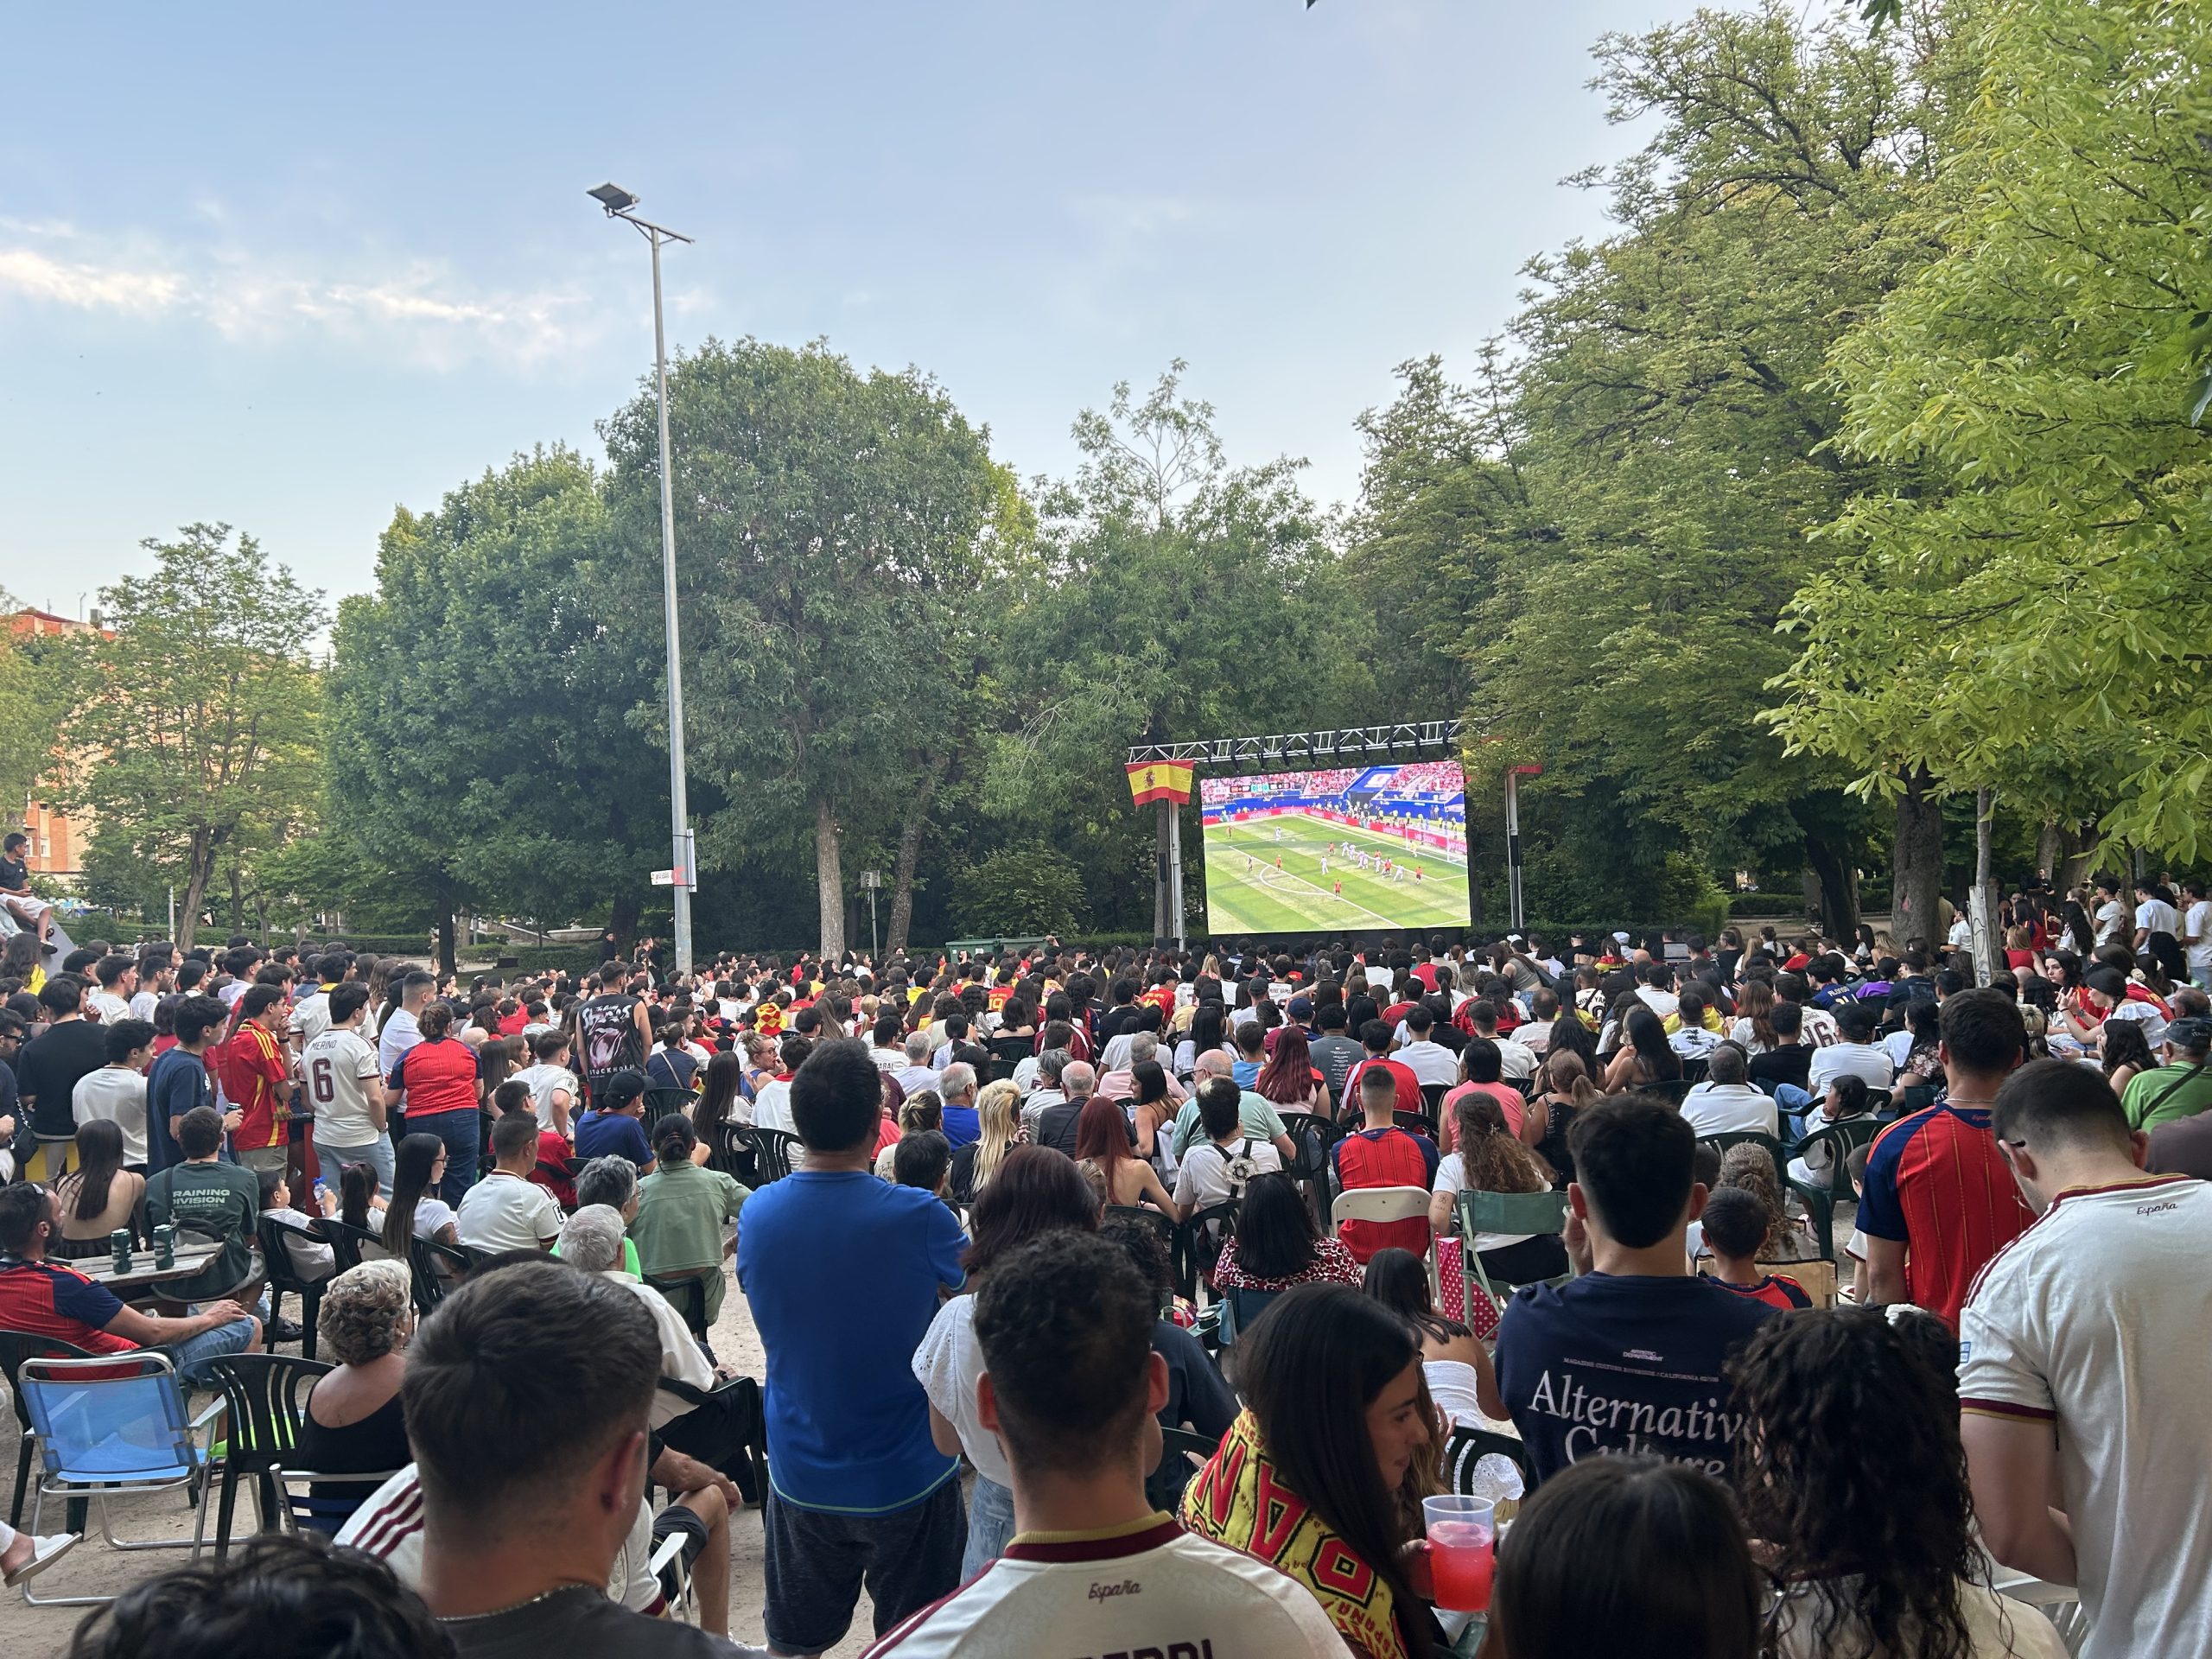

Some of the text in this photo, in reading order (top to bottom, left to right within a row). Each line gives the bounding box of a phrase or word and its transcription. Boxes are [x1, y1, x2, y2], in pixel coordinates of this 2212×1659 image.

[1803, 1022, 1834, 1047] 16
[311, 1039, 337, 1051] MERINO
[589, 1064, 636, 1076] STOCKHOLM
[312, 1057, 335, 1103] 6
[173, 1189, 231, 1198] RAINING
[2137, 1202, 2178, 1217] España
[1089, 1580, 1141, 1604] España
